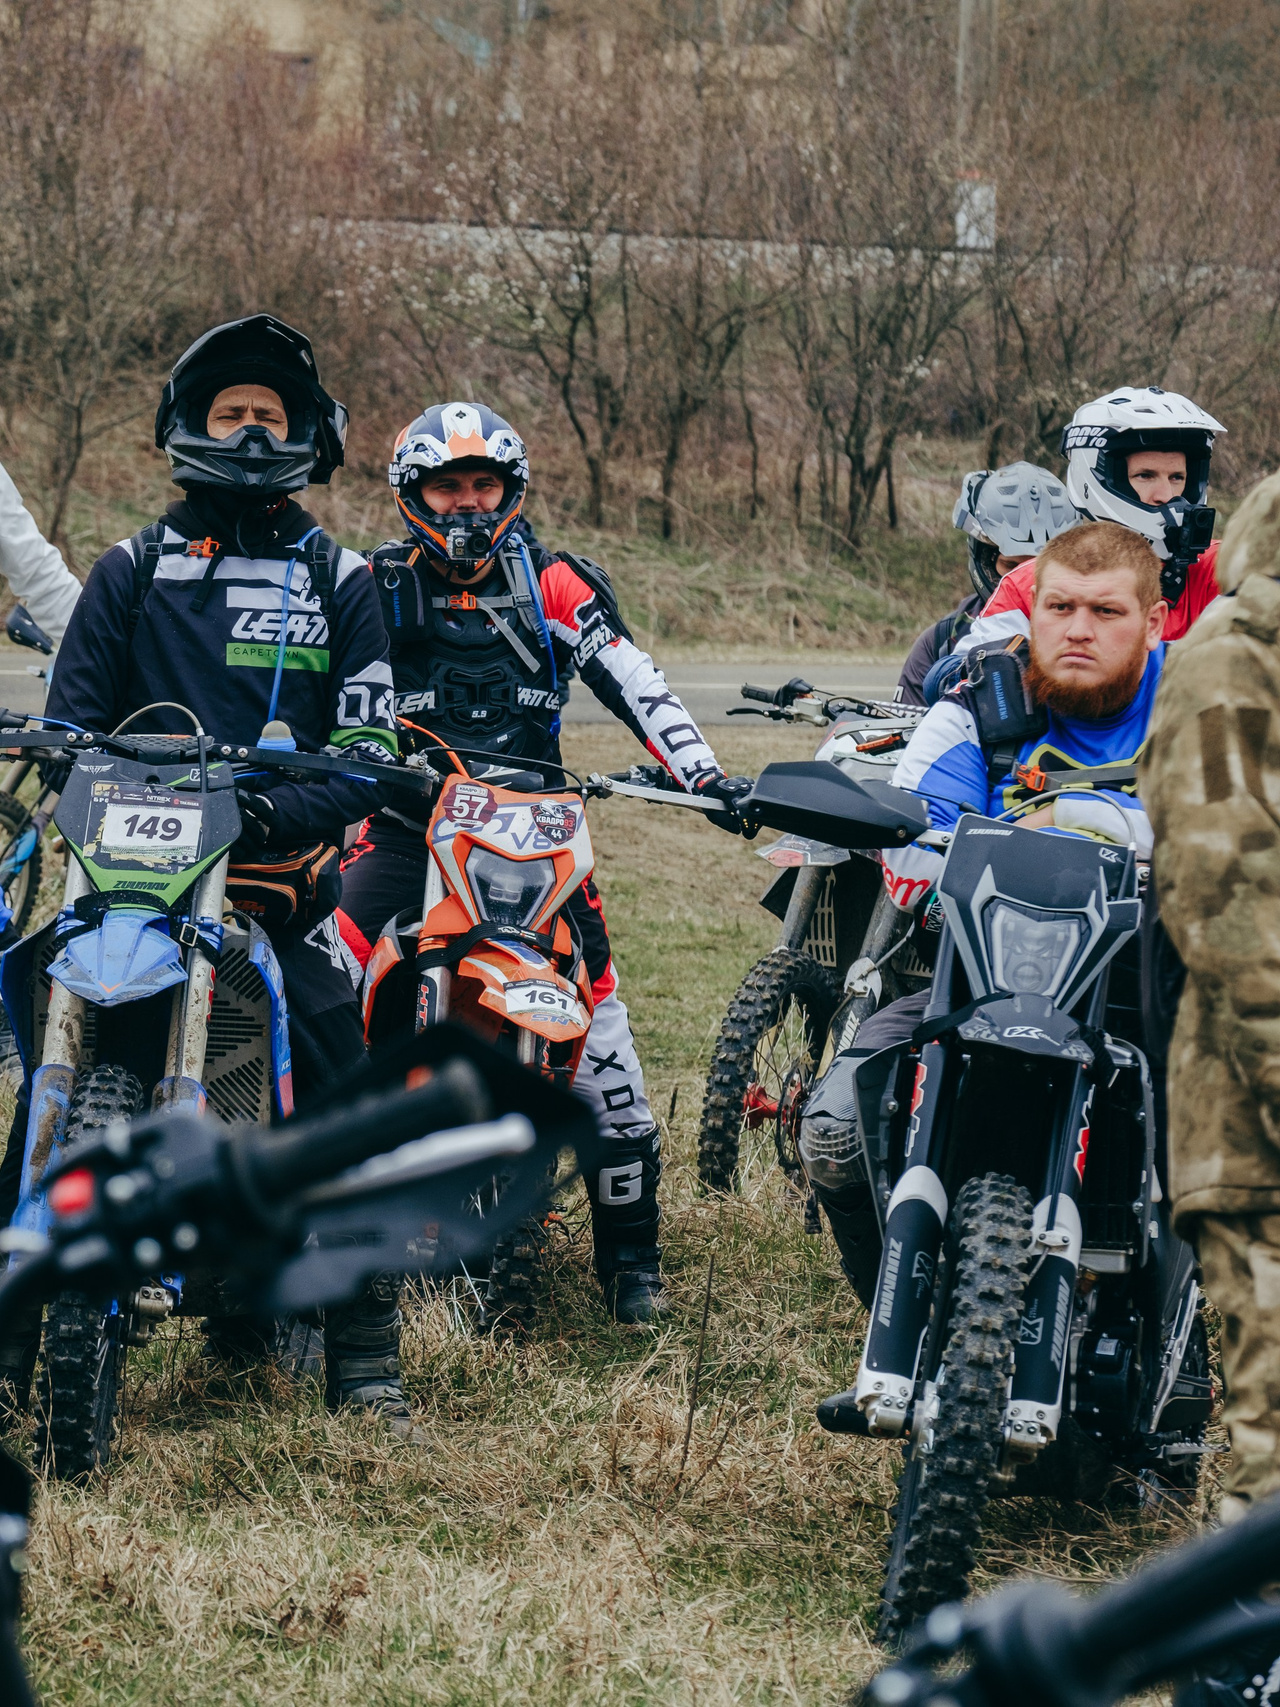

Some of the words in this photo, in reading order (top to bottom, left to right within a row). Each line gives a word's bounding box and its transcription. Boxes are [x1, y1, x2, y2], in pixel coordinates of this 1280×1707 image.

[146, 794, 171, 804] NITREX
[452, 794, 489, 820] 57
[124, 814, 183, 842] 149
[536, 815, 564, 827] КВАДРО
[564, 819, 574, 828] 93
[550, 828, 563, 840] 44
[112, 879, 171, 891] ZUUMAV
[525, 990, 568, 1010] 161
[878, 1237, 903, 1328] ZUUMAV
[1050, 1275, 1070, 1373] ZUUMAV
